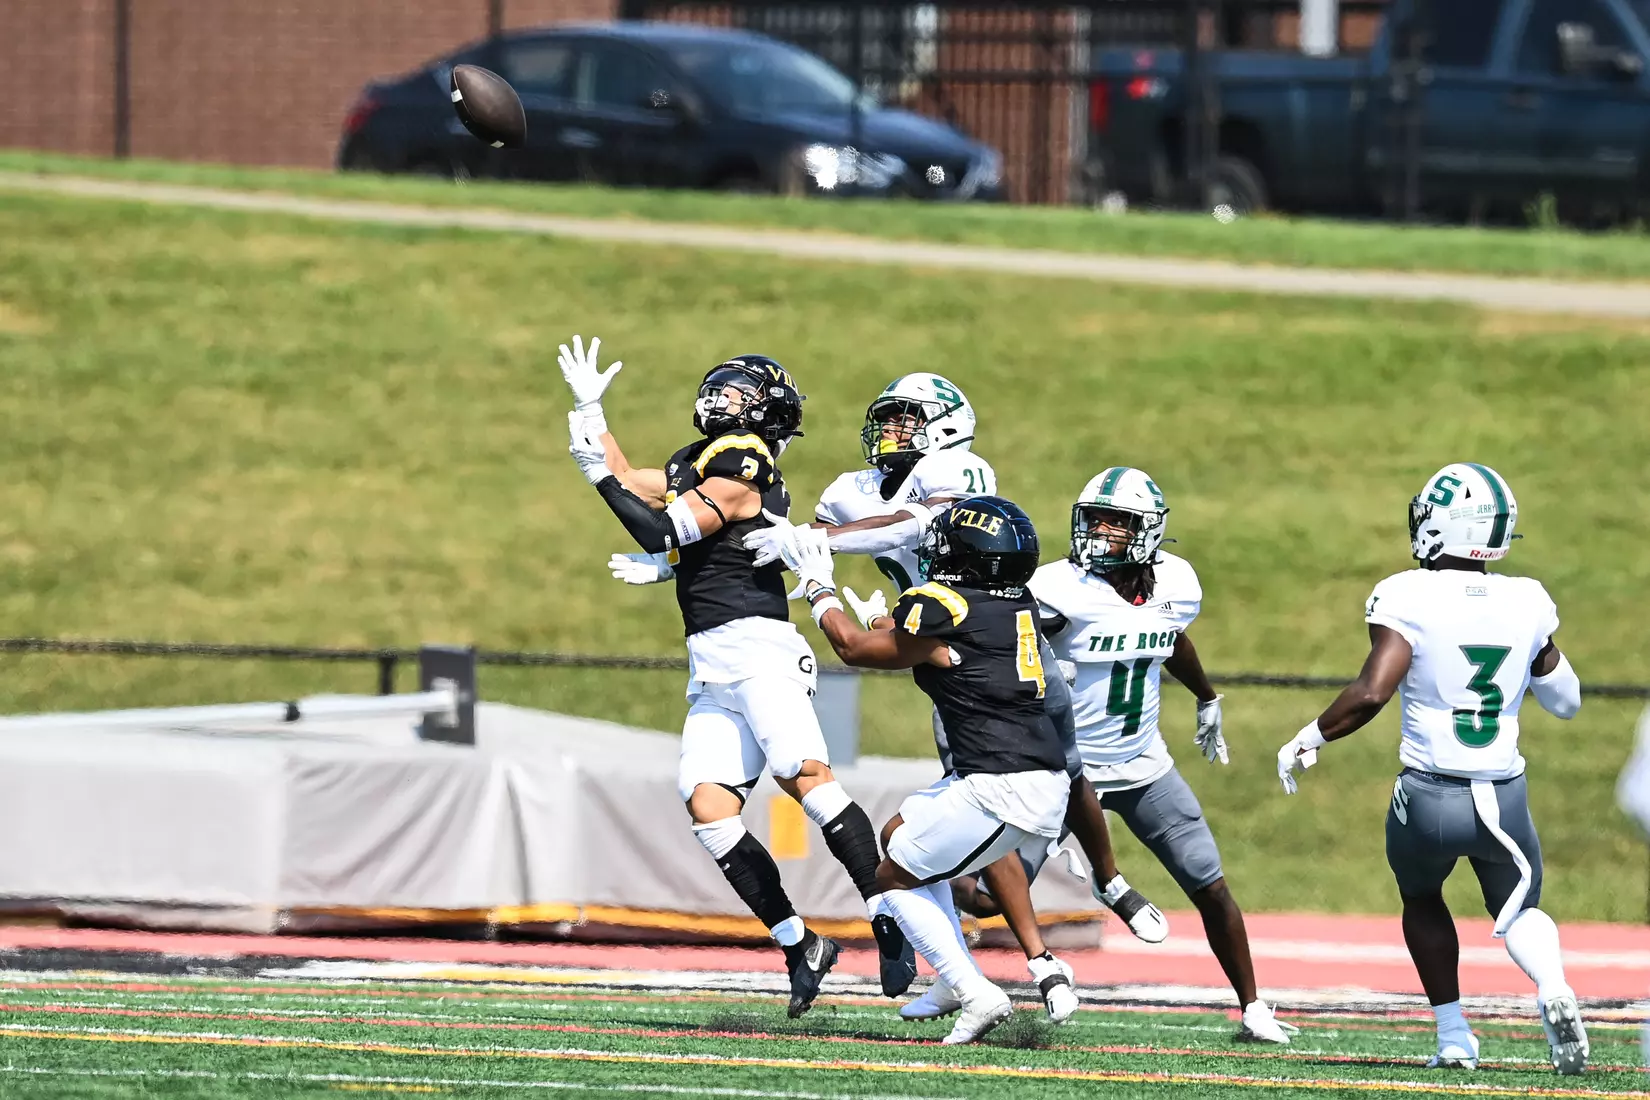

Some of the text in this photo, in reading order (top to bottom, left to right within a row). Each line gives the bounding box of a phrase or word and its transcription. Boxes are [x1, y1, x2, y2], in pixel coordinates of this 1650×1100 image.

[962, 467, 987, 494] 21
[1427, 474, 1463, 508] S
[903, 602, 924, 636] 4
[1014, 609, 1047, 699] 4
[1088, 633, 1127, 652] THE
[1106, 657, 1154, 737] 4
[1452, 644, 1512, 748] 3
